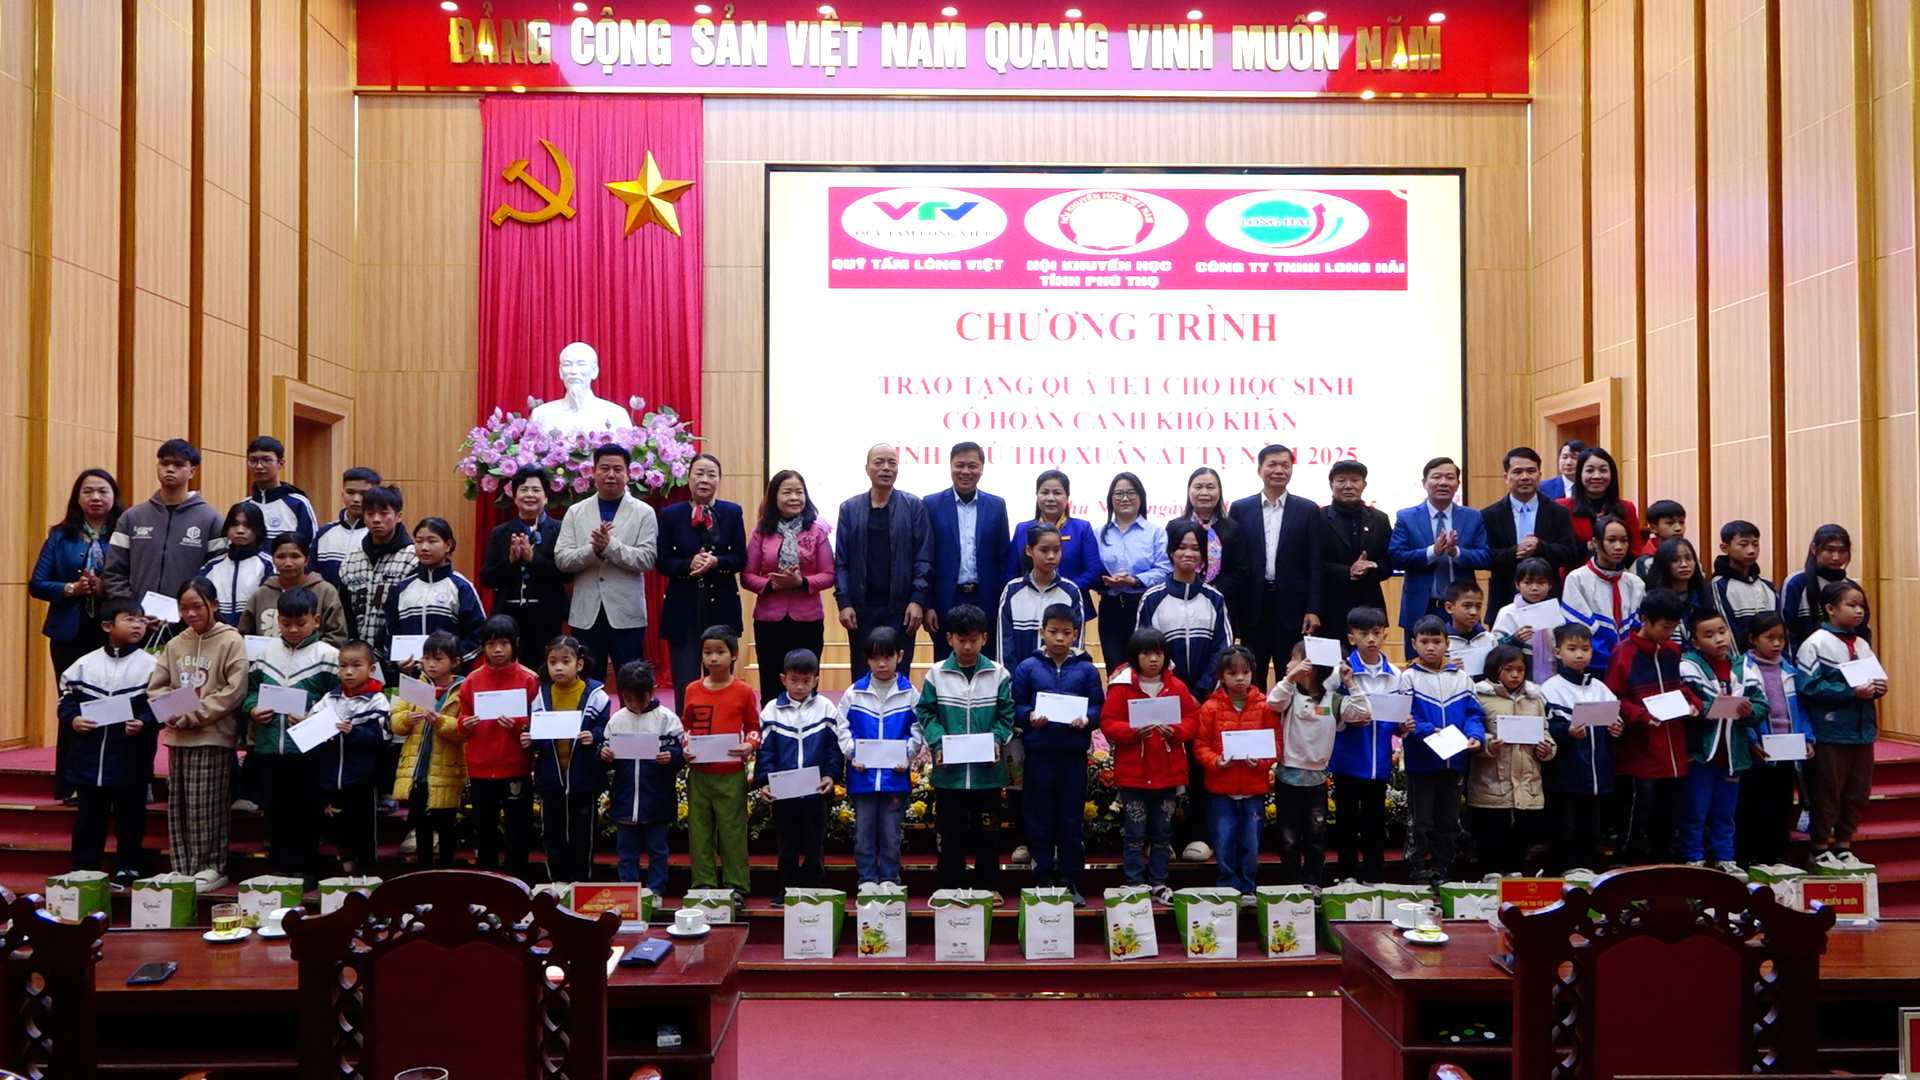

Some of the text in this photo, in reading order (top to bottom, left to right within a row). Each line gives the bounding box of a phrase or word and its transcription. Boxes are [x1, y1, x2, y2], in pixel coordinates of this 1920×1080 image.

[449, 3, 1441, 77] ĐẢNG CỘNG SẢN VIỆT NAM QUANG VINH MUÔN NĂM
[872, 201, 980, 221] VTV
[965, 257, 1004, 272] VIỆT
[1026, 257, 1172, 273] HỘI KHUYẾN HỌC
[1195, 259, 1405, 273] CÔNG TY TNHH LONG HẢI
[1039, 273, 1160, 288] TỈNH PHÚ THỌ
[956, 304, 1277, 341] CHƯƠNG TRÌNH
[878, 376, 953, 396] TRAO
[1042, 371, 1097, 398] QUÀ
[1163, 376, 1221, 396] CHO
[1230, 376, 1285, 400] HỌC
[1293, 376, 1354, 396] SINH
[943, 406, 981, 430] CÓ
[989, 406, 1064, 430] HOÀN
[1157, 407, 1215, 430] KHÓ
[1223, 408, 1297, 430] KHĂN
[1010, 446, 1067, 471] THỌ
[1076, 441, 1146, 466] XUÂN
[1197, 446, 1232, 470] TỴ
[1308, 446, 1358, 466] 2025
